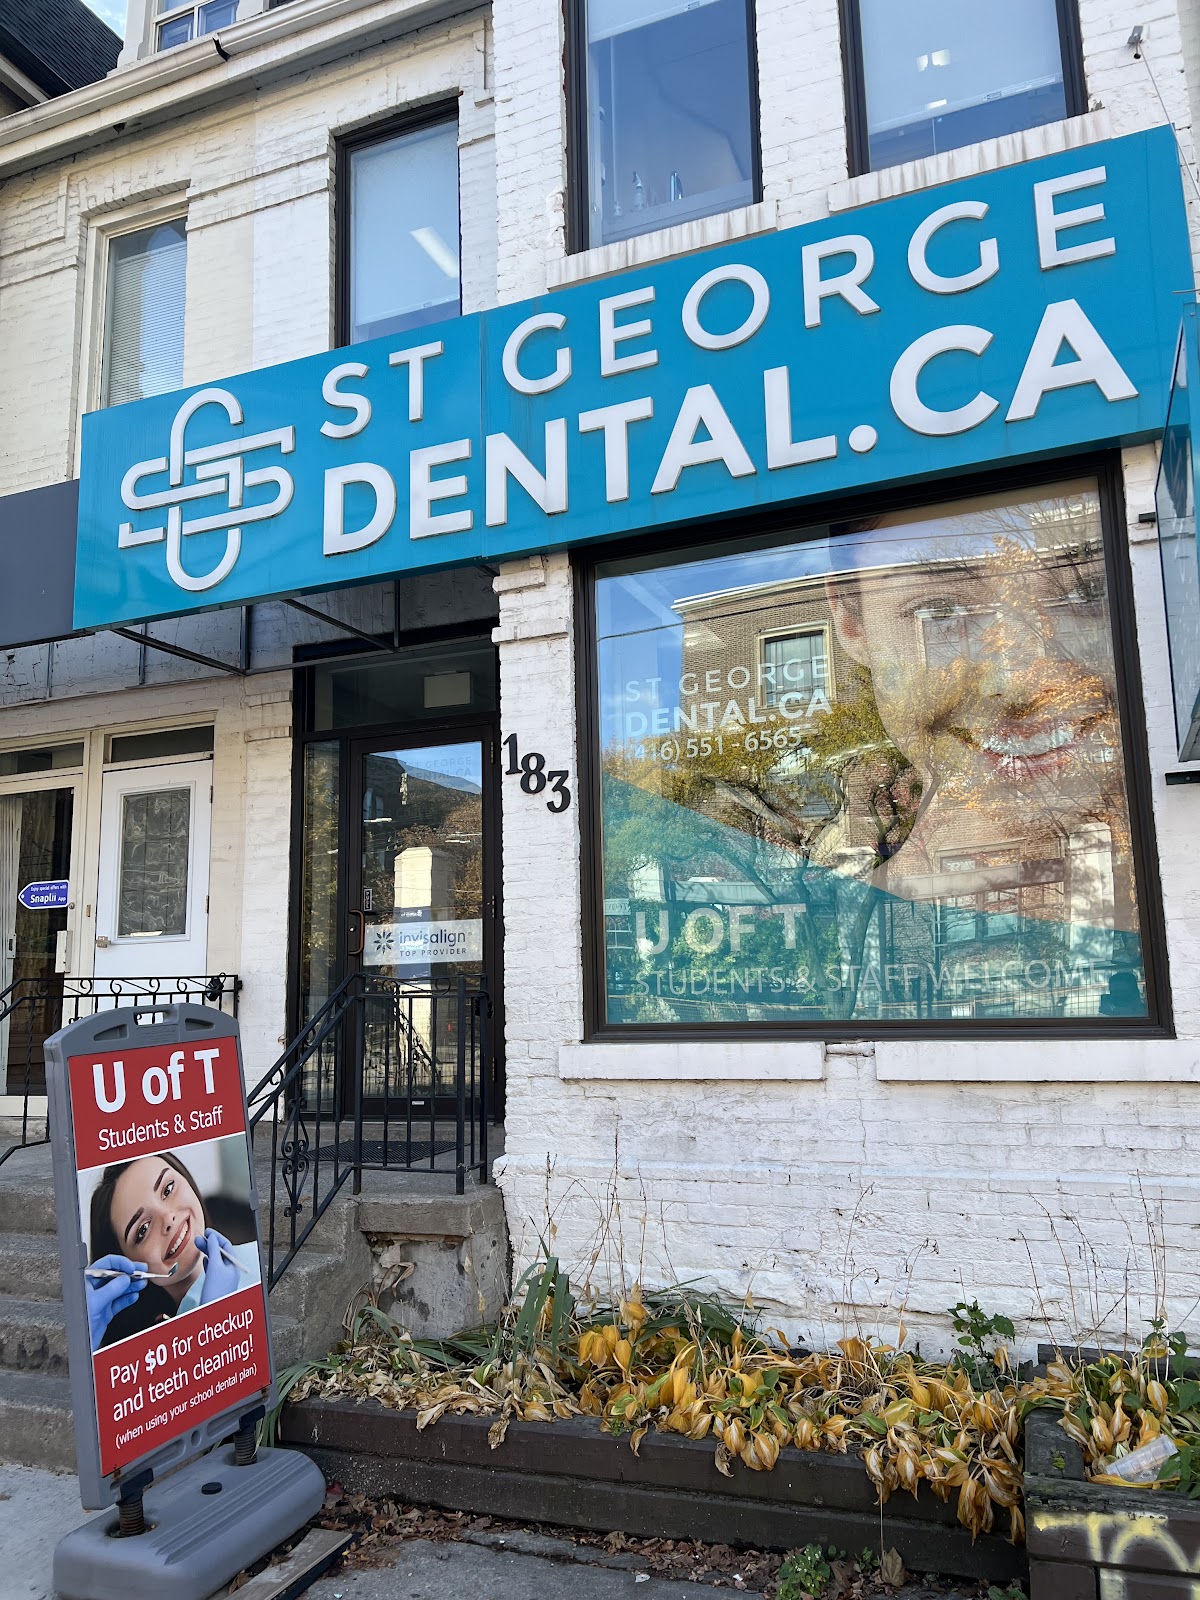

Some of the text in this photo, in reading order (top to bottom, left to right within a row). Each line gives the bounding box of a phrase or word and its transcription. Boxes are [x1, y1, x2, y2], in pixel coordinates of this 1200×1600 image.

[319, 166, 1116, 439] ST GEORGE
[323, 298, 1138, 556] DENTAL.CA
[625, 655, 829, 701] ST GEORGE
[625, 689, 833, 738] DENTAL.CA
[425, 756, 472, 769] GEORGE
[502, 732, 572, 813] 183
[30, 893, 57, 904] Snaplii
[399, 929, 466, 947] invisalign
[421, 948, 467, 956] PROVIDER
[635, 909, 670, 955] U
[635, 957, 1106, 996] STUDENTS & STAFF WELCOME
[92, 1047, 220, 1113] U of T
[98, 1105, 223, 1151] Students & Staff
[109, 1308, 254, 1389] Pay $0 for checkup
[113, 1333, 255, 1422] and teeth cleaning!
[115, 1363, 257, 1450] (when using your school dental plan)
